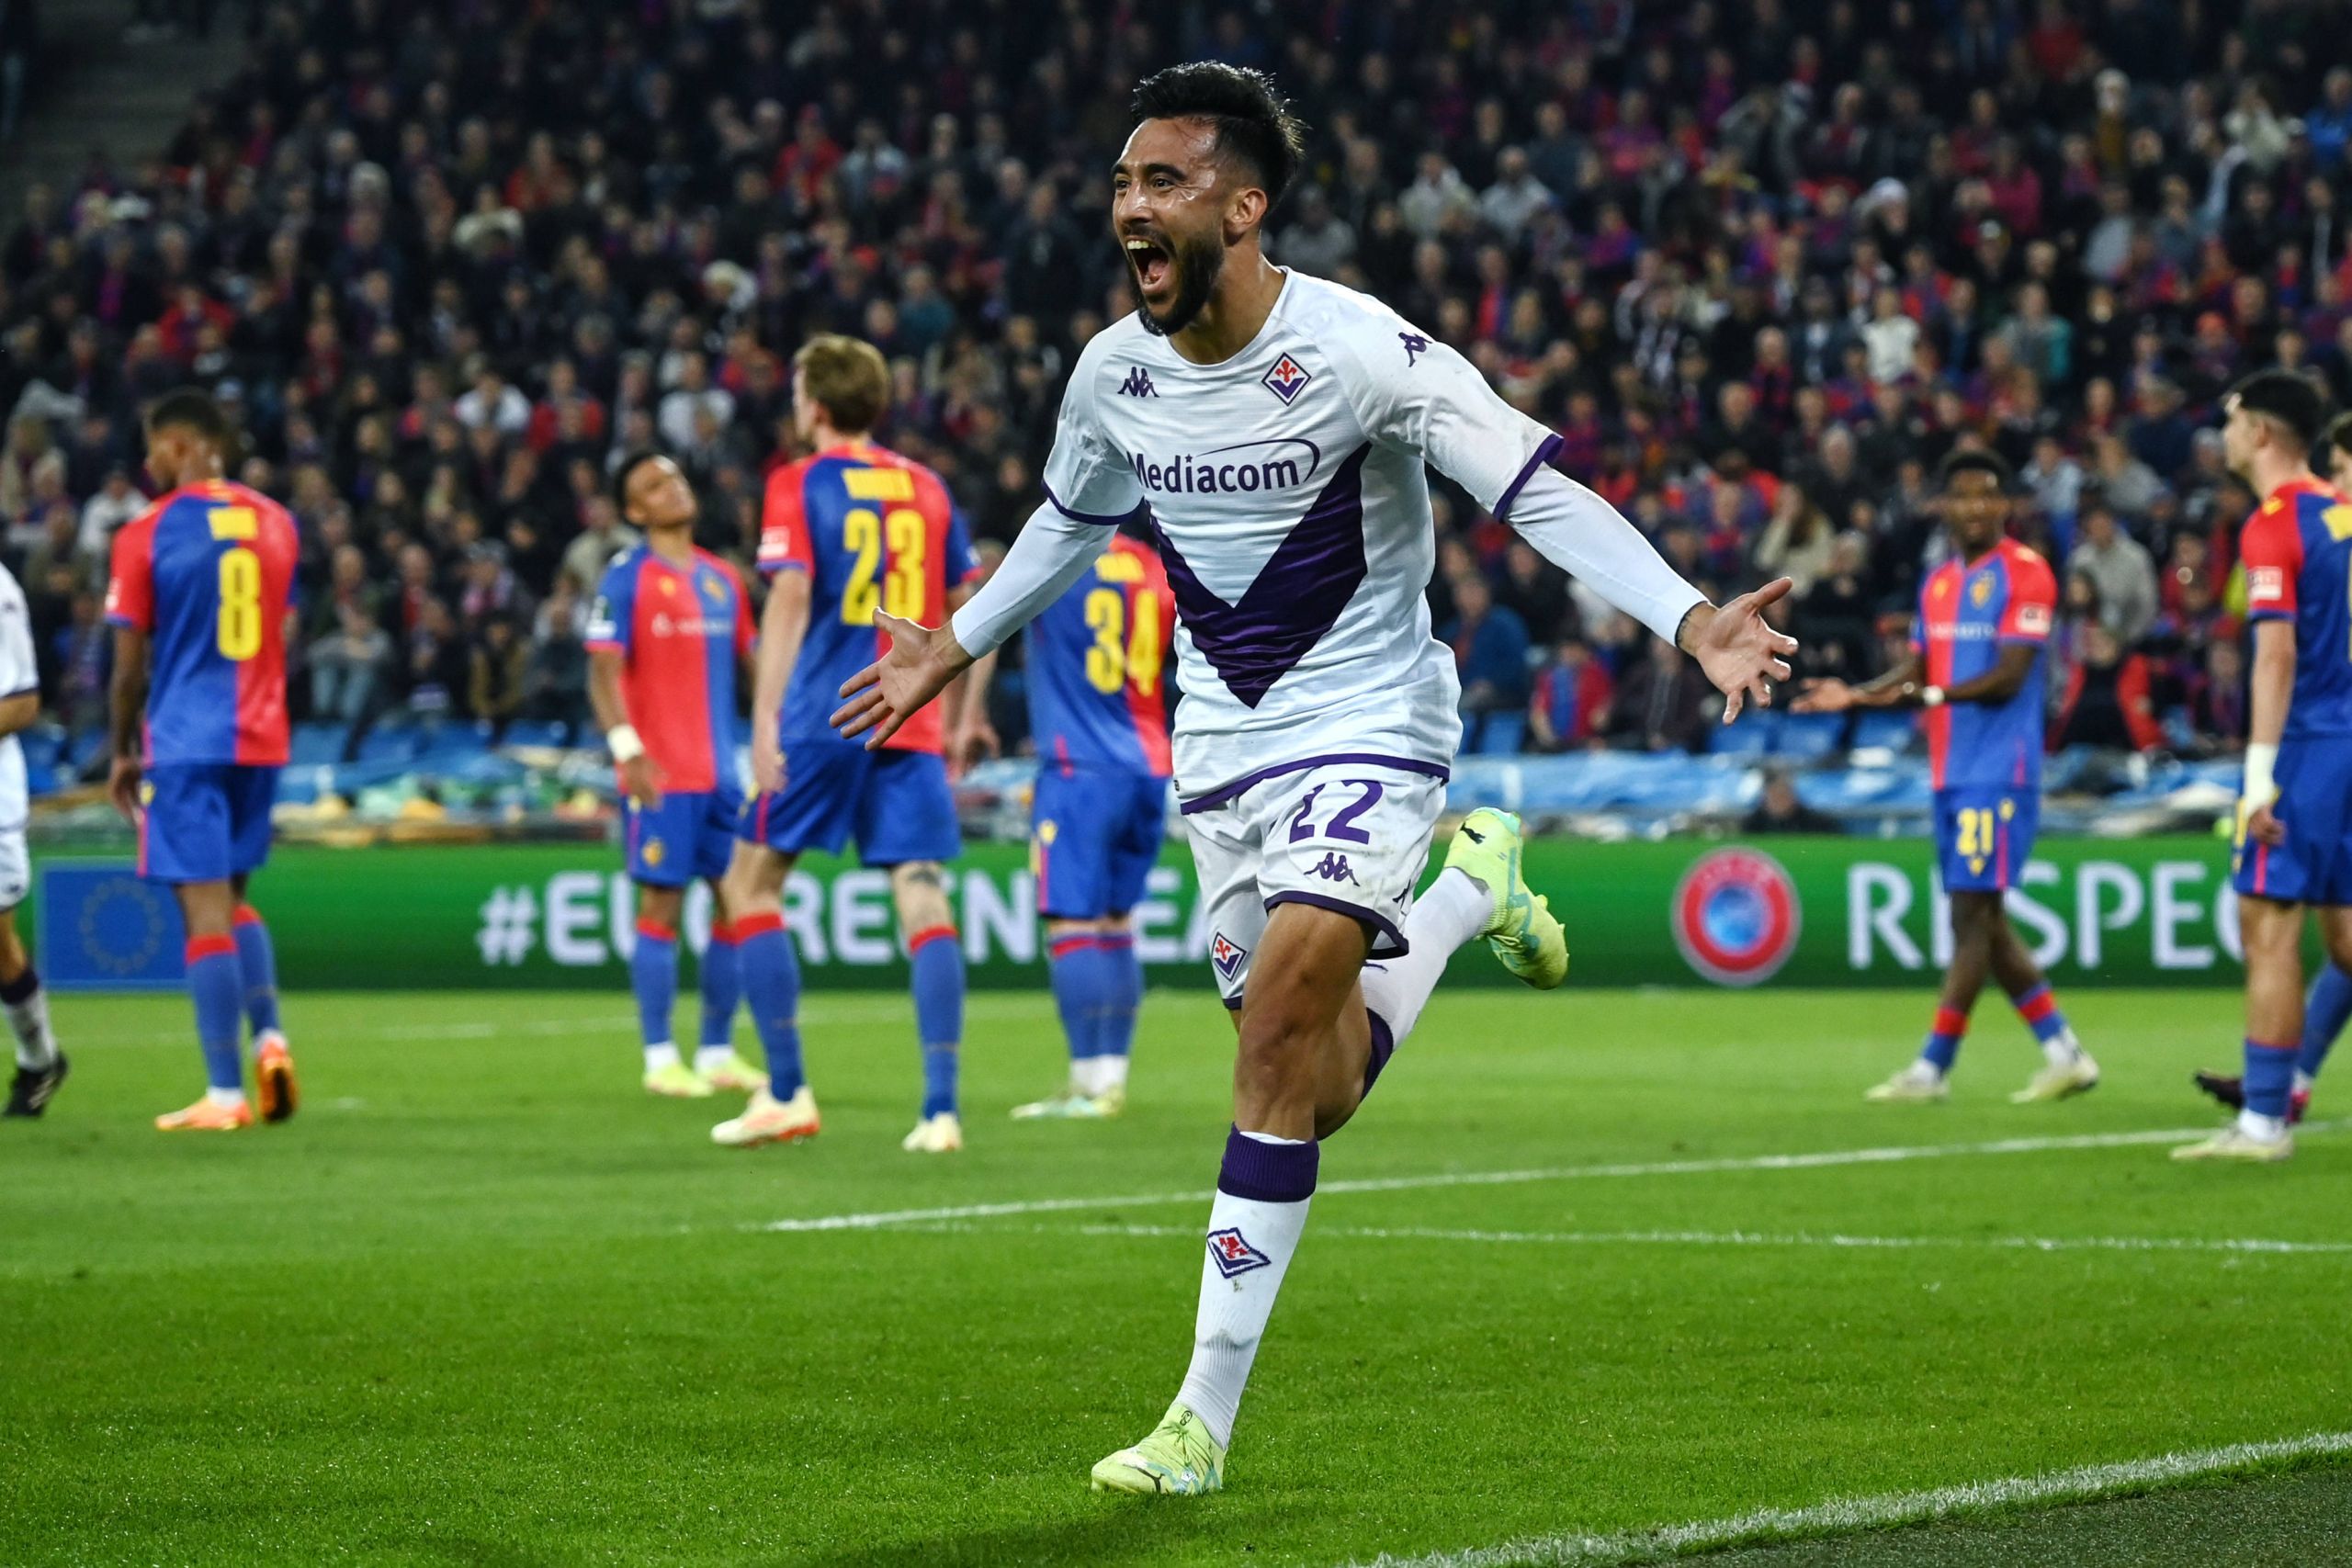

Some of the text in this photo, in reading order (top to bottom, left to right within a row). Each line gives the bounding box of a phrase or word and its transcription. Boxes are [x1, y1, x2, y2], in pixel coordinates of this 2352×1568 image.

[1126, 451, 1300, 493] Mediacom
[217, 547, 263, 660] 8
[841, 508, 926, 626] 23
[1084, 588, 1161, 696] 34
[1288, 779, 1384, 845] 22
[1956, 807, 1994, 856] 21
